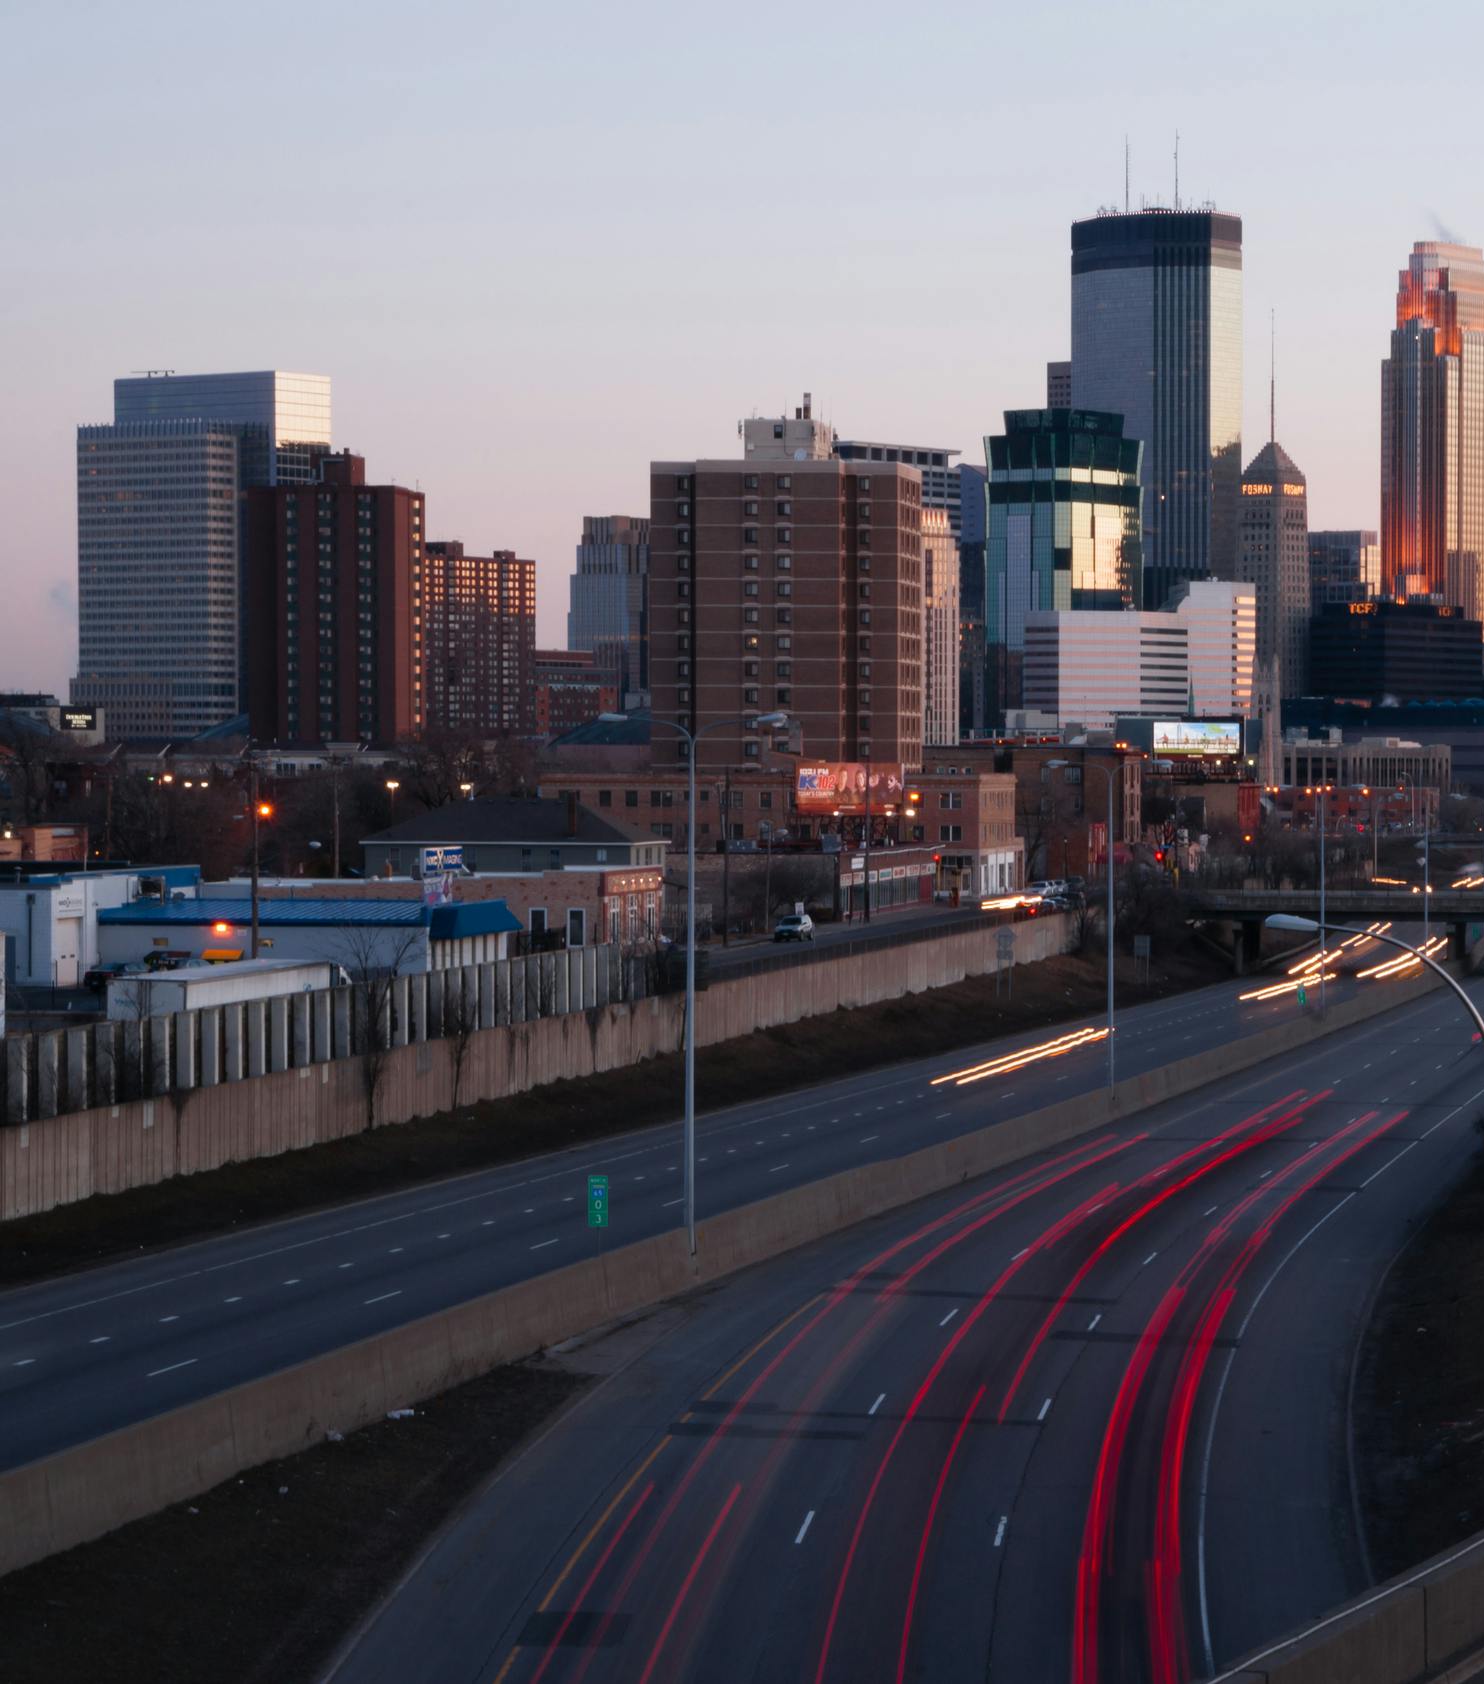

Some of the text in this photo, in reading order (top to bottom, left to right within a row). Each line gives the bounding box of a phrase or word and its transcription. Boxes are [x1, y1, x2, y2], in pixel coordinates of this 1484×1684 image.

[1242, 484, 1272, 495] FOSHAY
[1348, 603, 1373, 614] TCF
[595, 1200, 602, 1210] 0
[595, 1214, 601, 1224] 3
